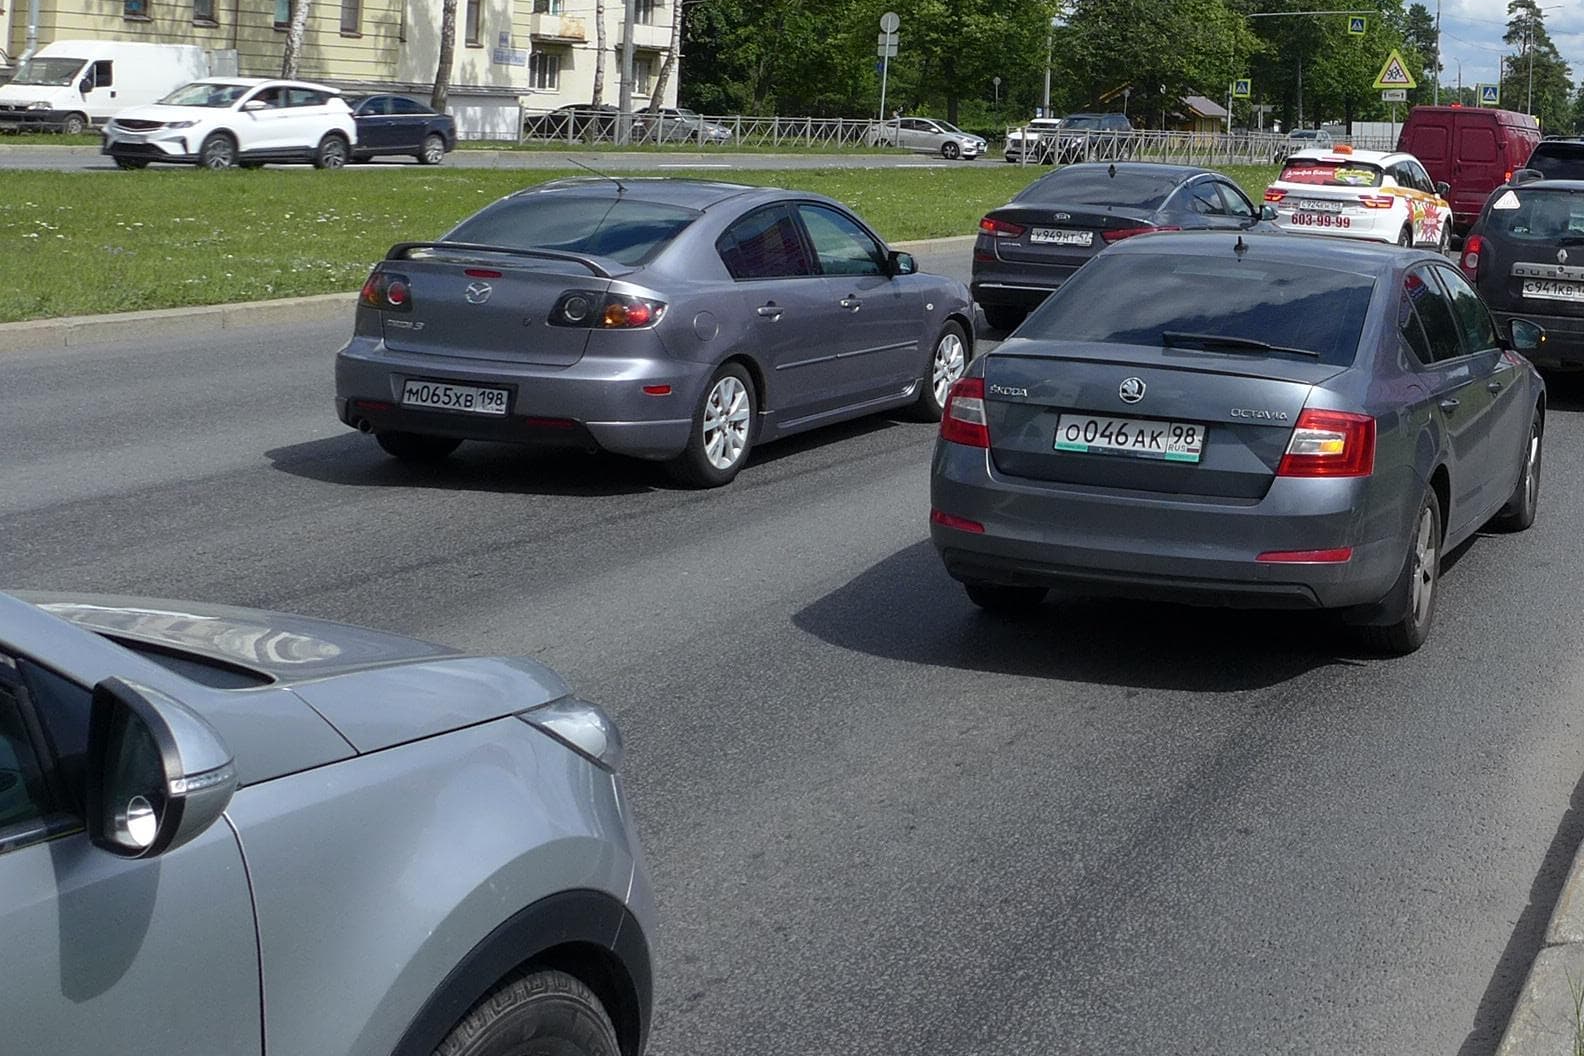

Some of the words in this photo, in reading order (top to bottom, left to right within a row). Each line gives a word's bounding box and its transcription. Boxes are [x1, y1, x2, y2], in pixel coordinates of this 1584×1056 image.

[1291, 213, 1351, 228] 603-99-99
[478, 390, 504, 406] 198
[1230, 407, 1288, 421] OCTAVIA
[1172, 426, 1196, 445] 98
[1167, 444, 1186, 452] RUS
